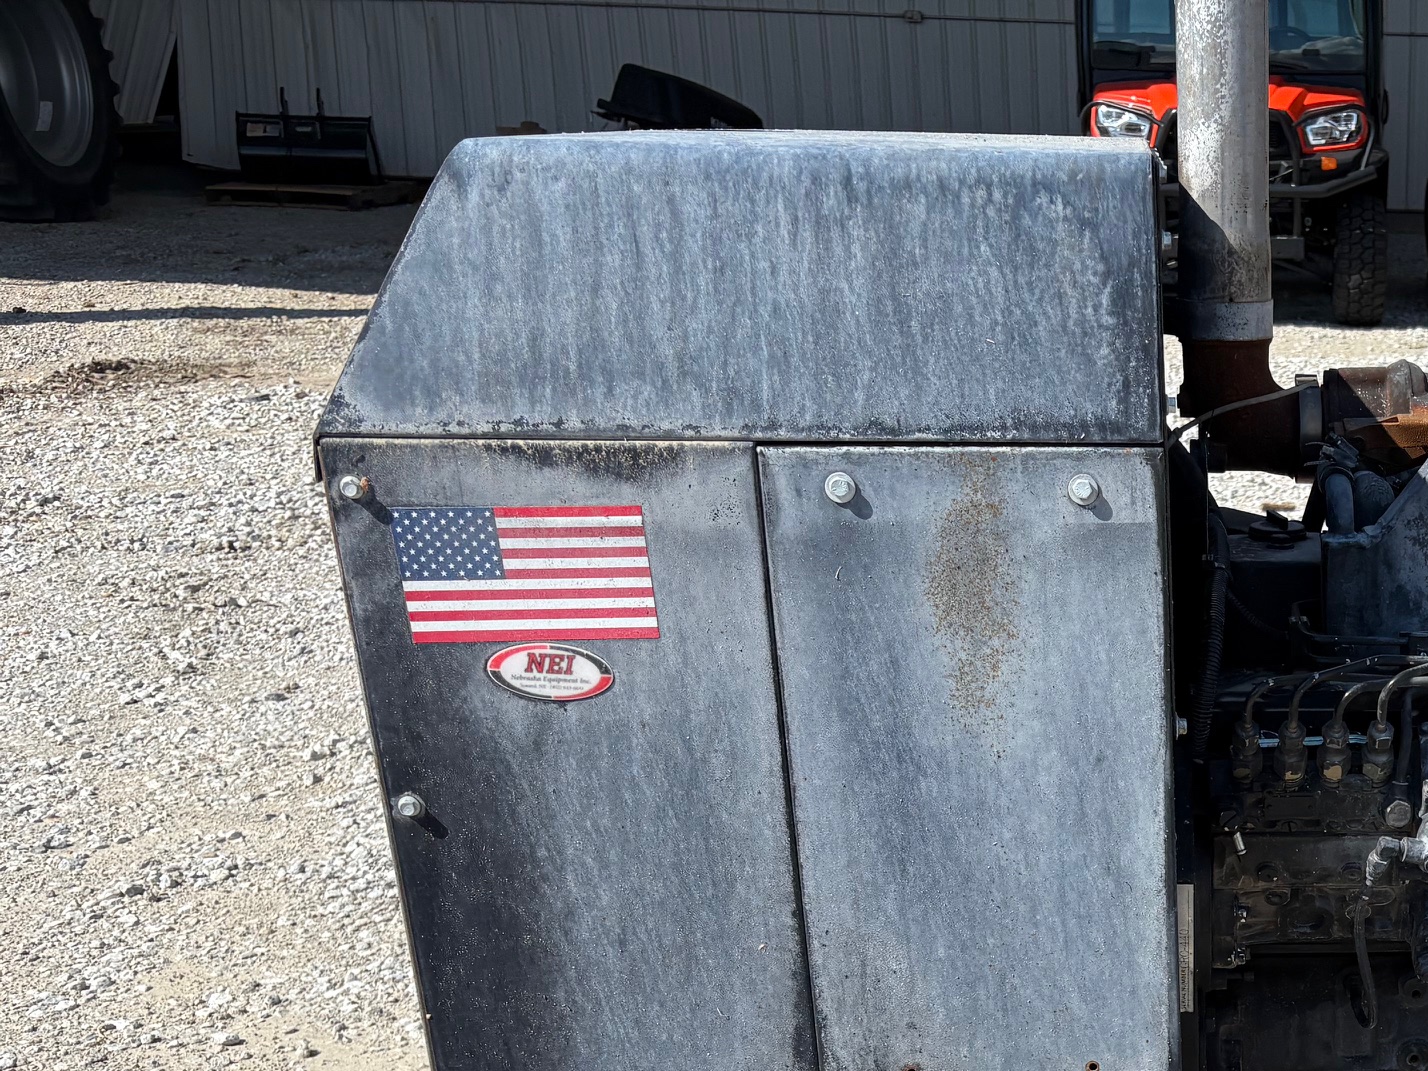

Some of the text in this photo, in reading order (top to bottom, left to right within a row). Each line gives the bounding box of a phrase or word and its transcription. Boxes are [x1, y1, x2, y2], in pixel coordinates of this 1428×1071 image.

[525, 652, 576, 675] NEI
[510, 674, 542, 682] Nebraska
[543, 676, 578, 684] Equipment
